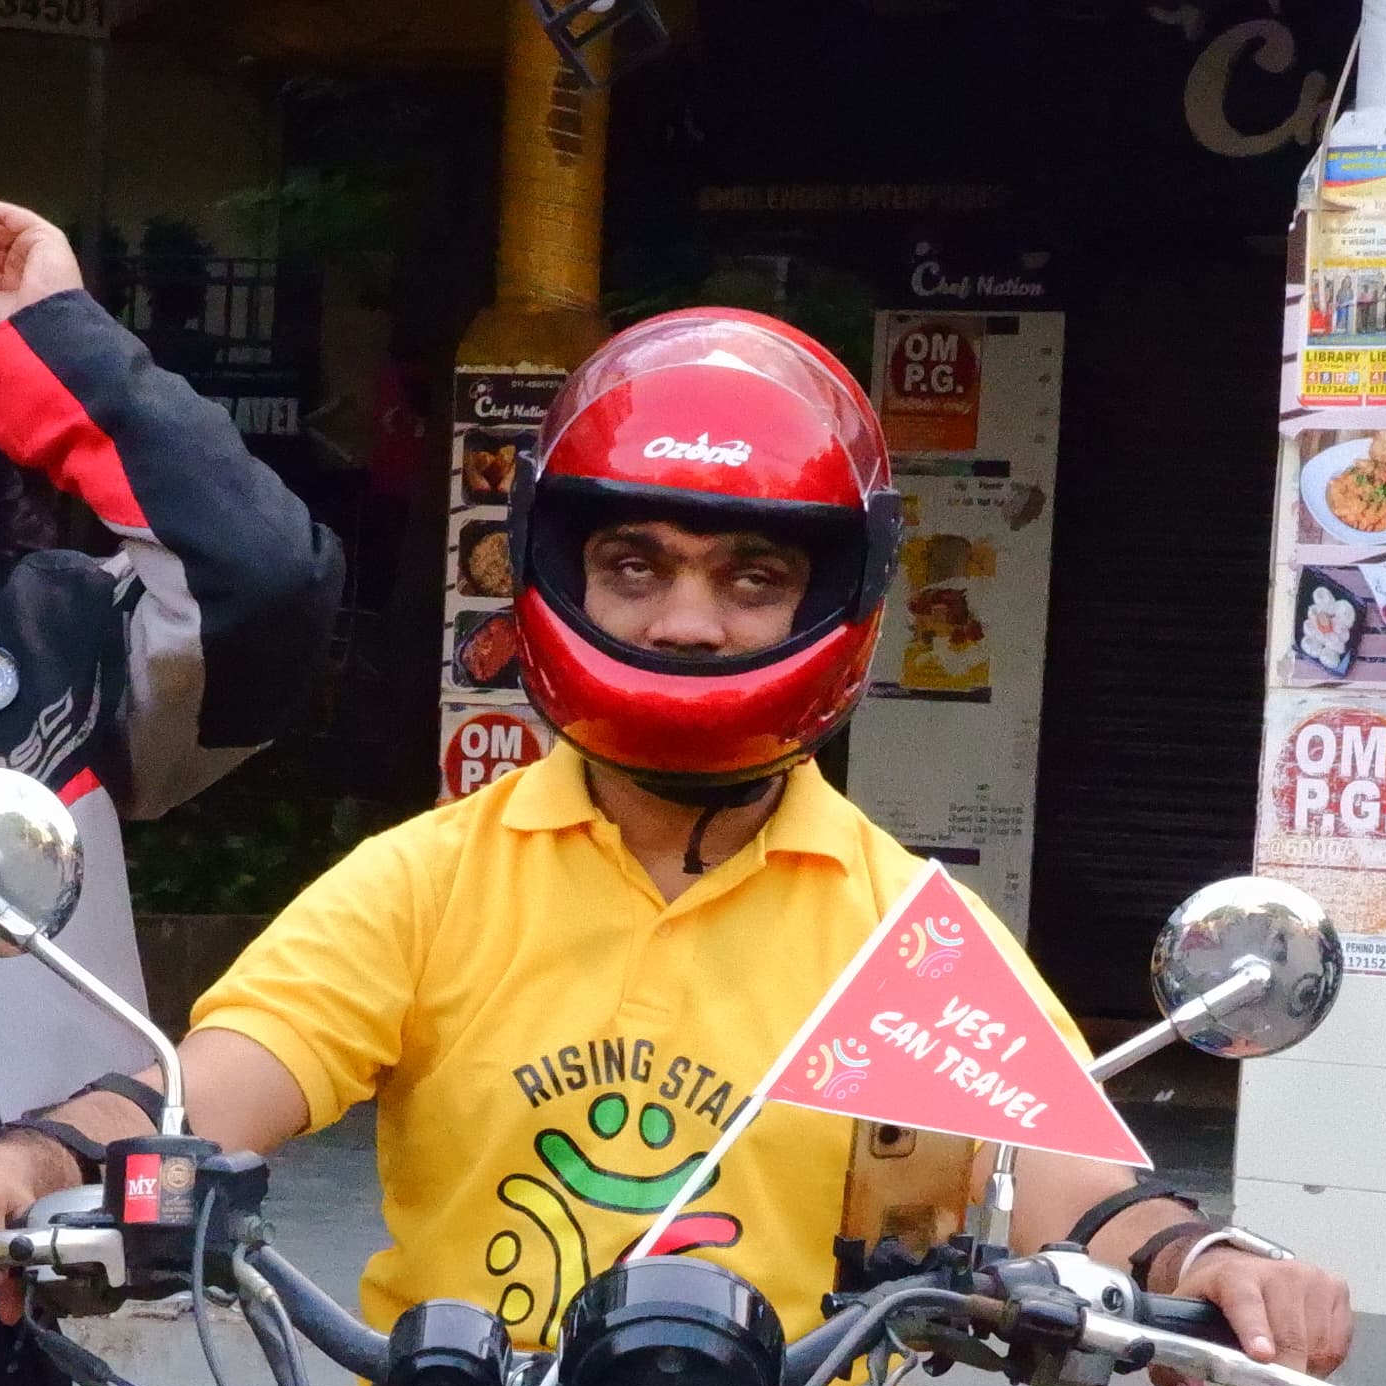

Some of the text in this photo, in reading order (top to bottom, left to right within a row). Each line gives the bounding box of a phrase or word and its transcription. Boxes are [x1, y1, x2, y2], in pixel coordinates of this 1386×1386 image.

[911, 261, 1046, 298] Chef Nation
[903, 333, 959, 363] OM
[1306, 351, 1361, 363] LIBRARY
[902, 363, 966, 394] P.G.
[474, 396, 511, 420] Chef
[643, 431, 752, 467] Ozone
[460, 723, 523, 759] OM
[934, 995, 1006, 1050] YES
[512, 1037, 655, 1109] RISING
[870, 1011, 1048, 1128] CAN TRAVEL
[128, 1177, 158, 1196] MY
